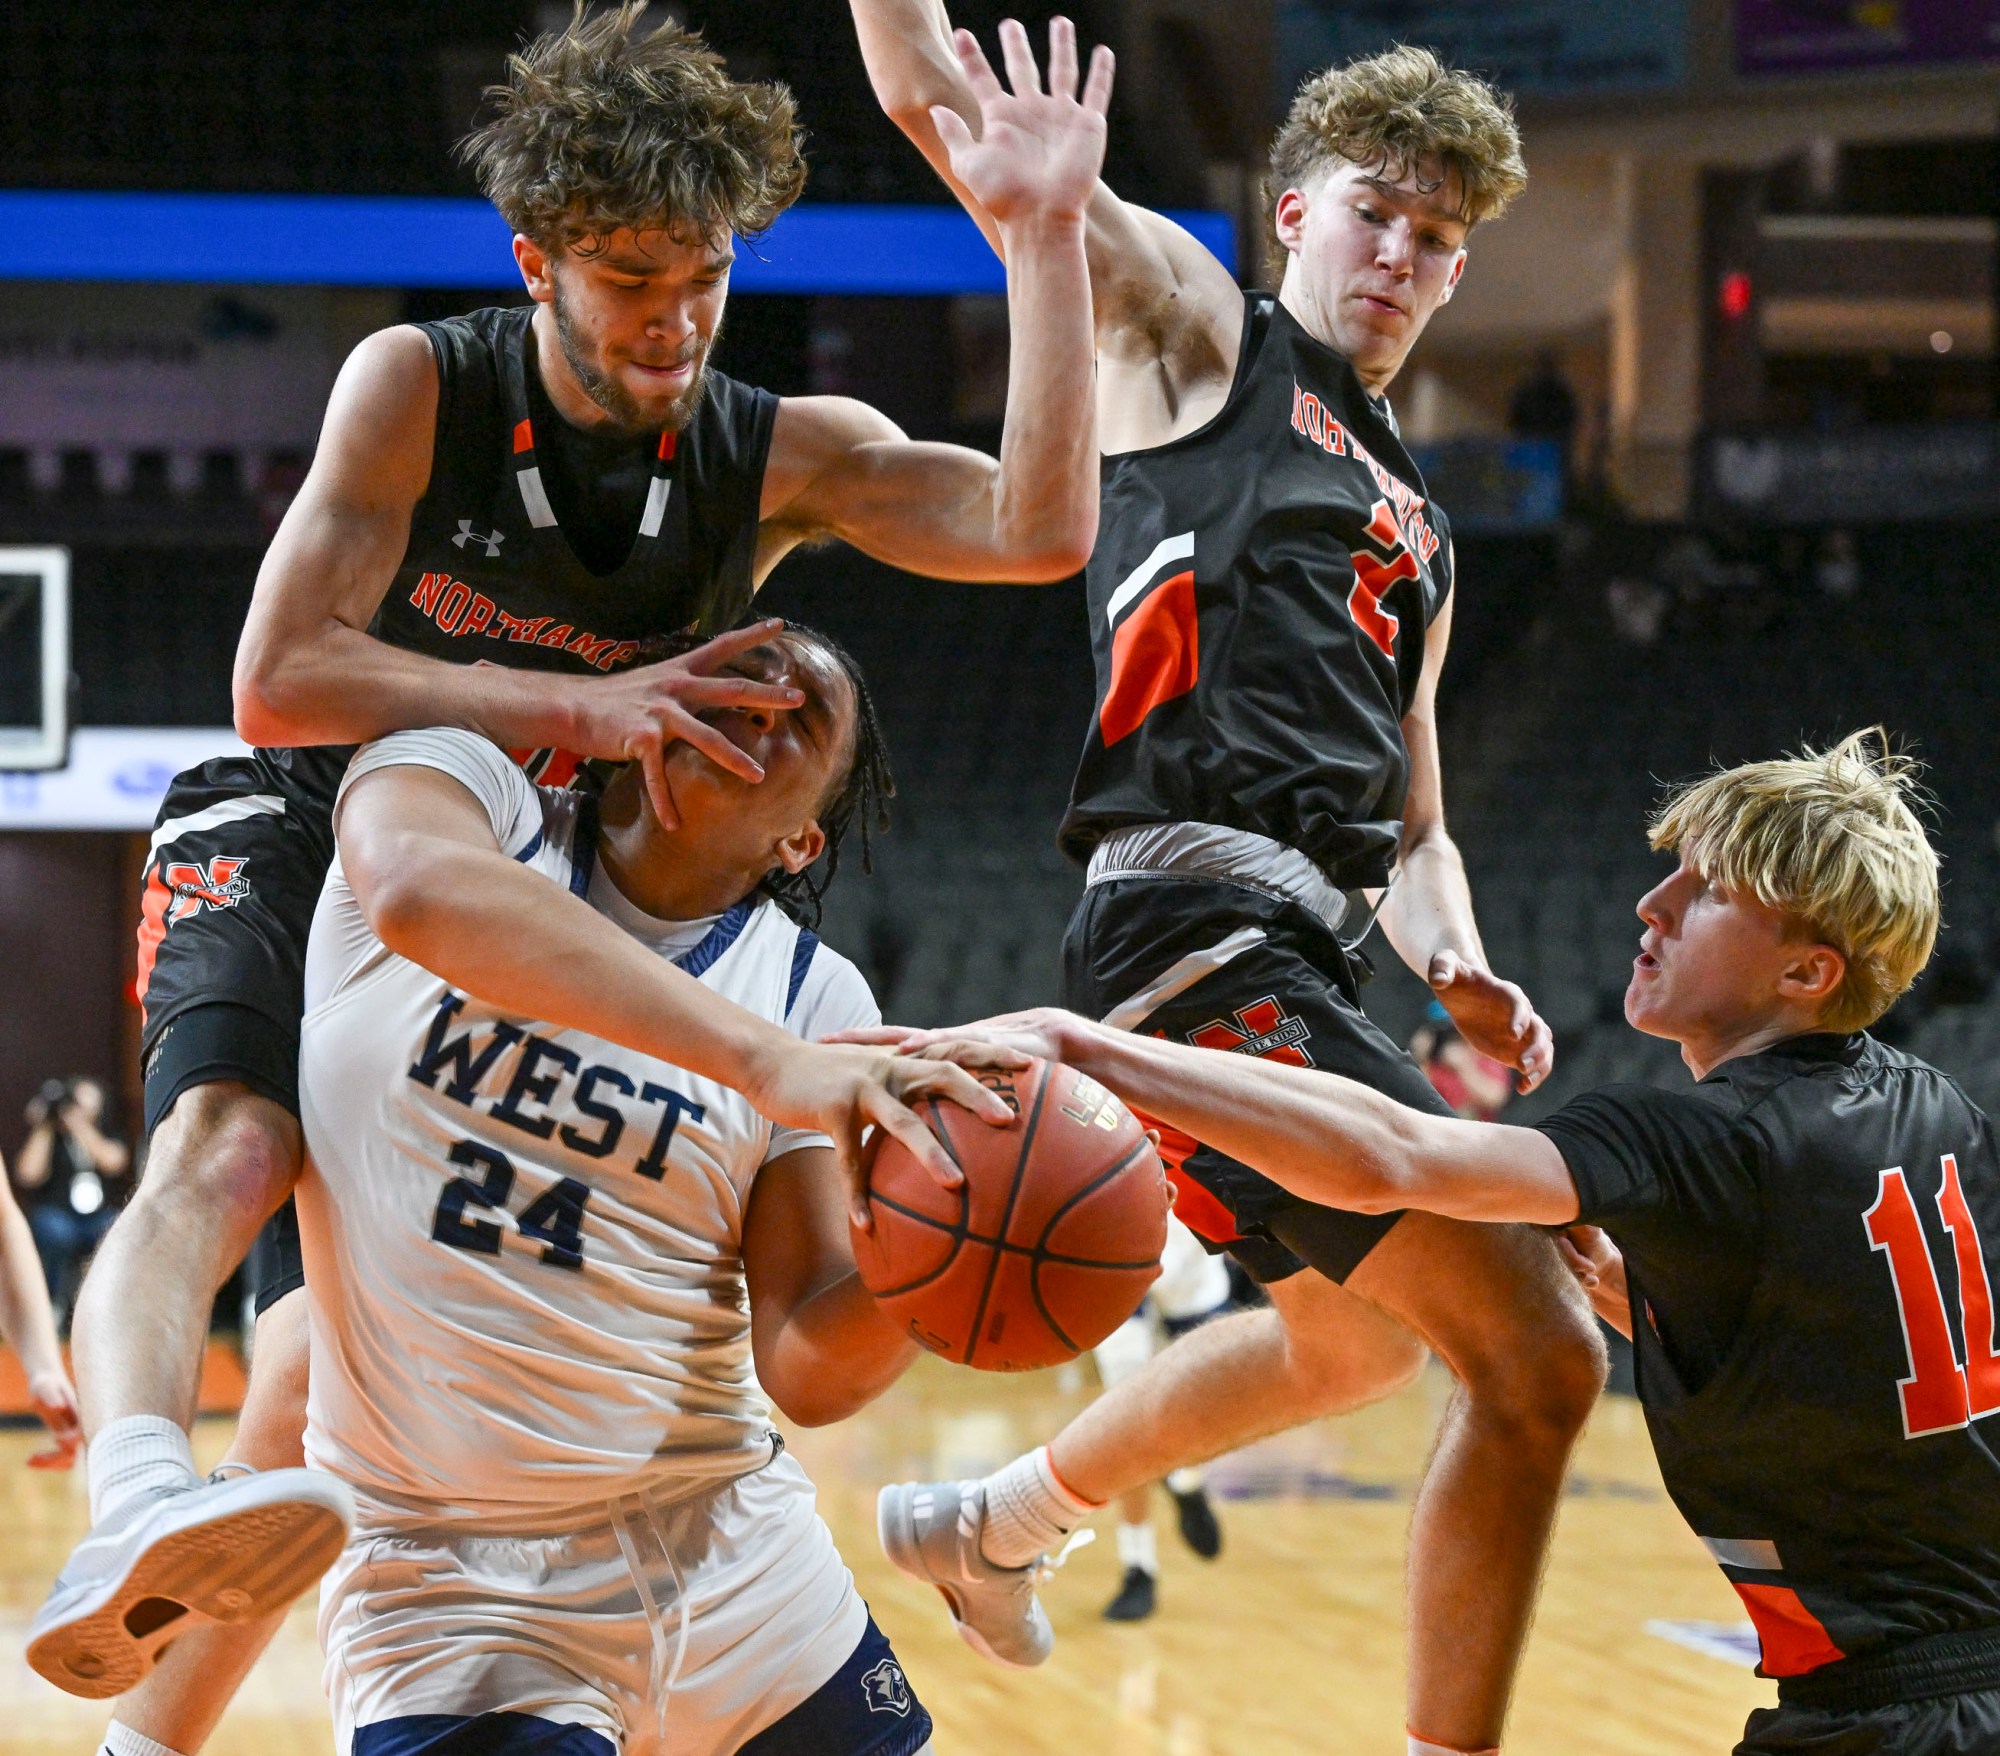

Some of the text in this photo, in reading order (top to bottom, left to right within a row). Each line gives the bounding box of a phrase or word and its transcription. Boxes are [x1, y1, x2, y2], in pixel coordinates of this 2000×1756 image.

[409, 572, 642, 672] NORTHAMP
[407, 991, 708, 1181] WEST
[1268, 1026, 1298, 1045] KIDS
[430, 1139, 591, 1269] 24
[1861, 1153, 2000, 1440] 11
